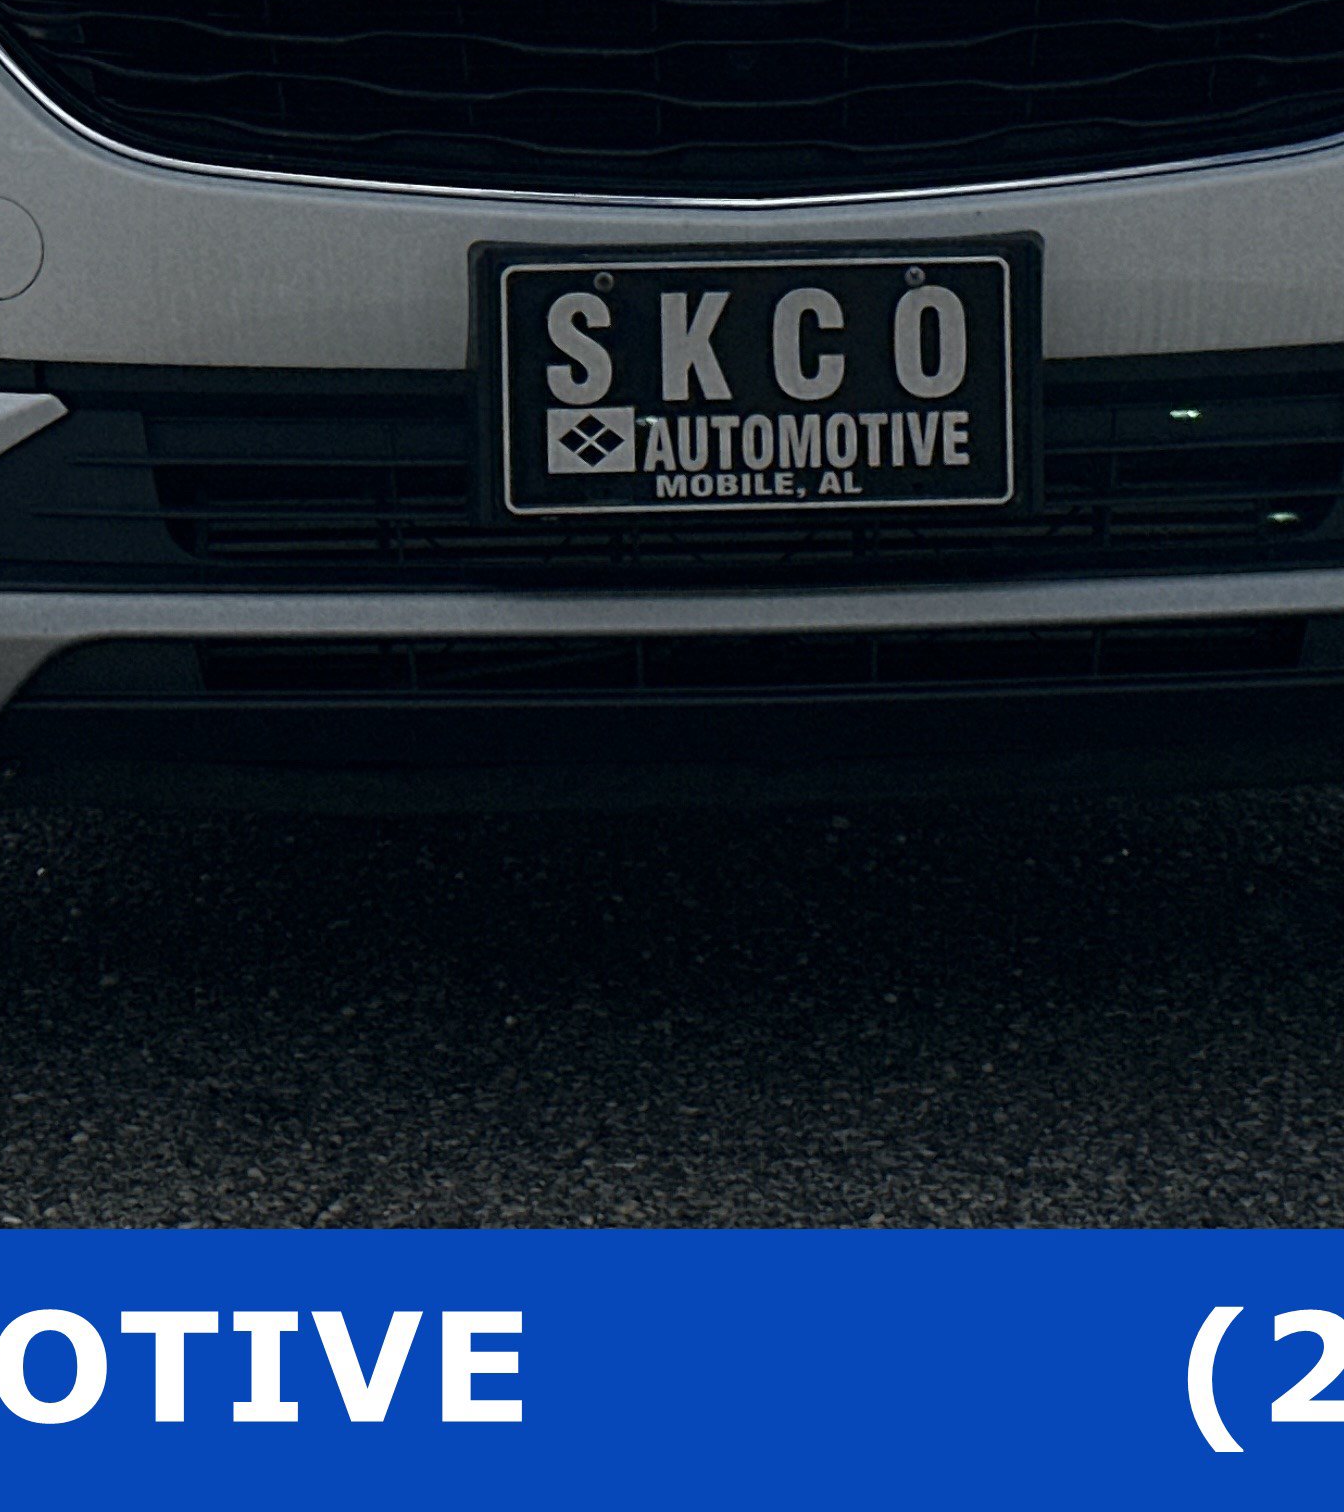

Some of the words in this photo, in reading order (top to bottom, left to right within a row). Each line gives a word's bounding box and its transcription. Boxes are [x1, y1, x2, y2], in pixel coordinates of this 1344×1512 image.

[642, 410, 971, 472] AUTOMOTIVE
[655, 472, 807, 499] MOBILE,
[818, 470, 863, 495] AL
